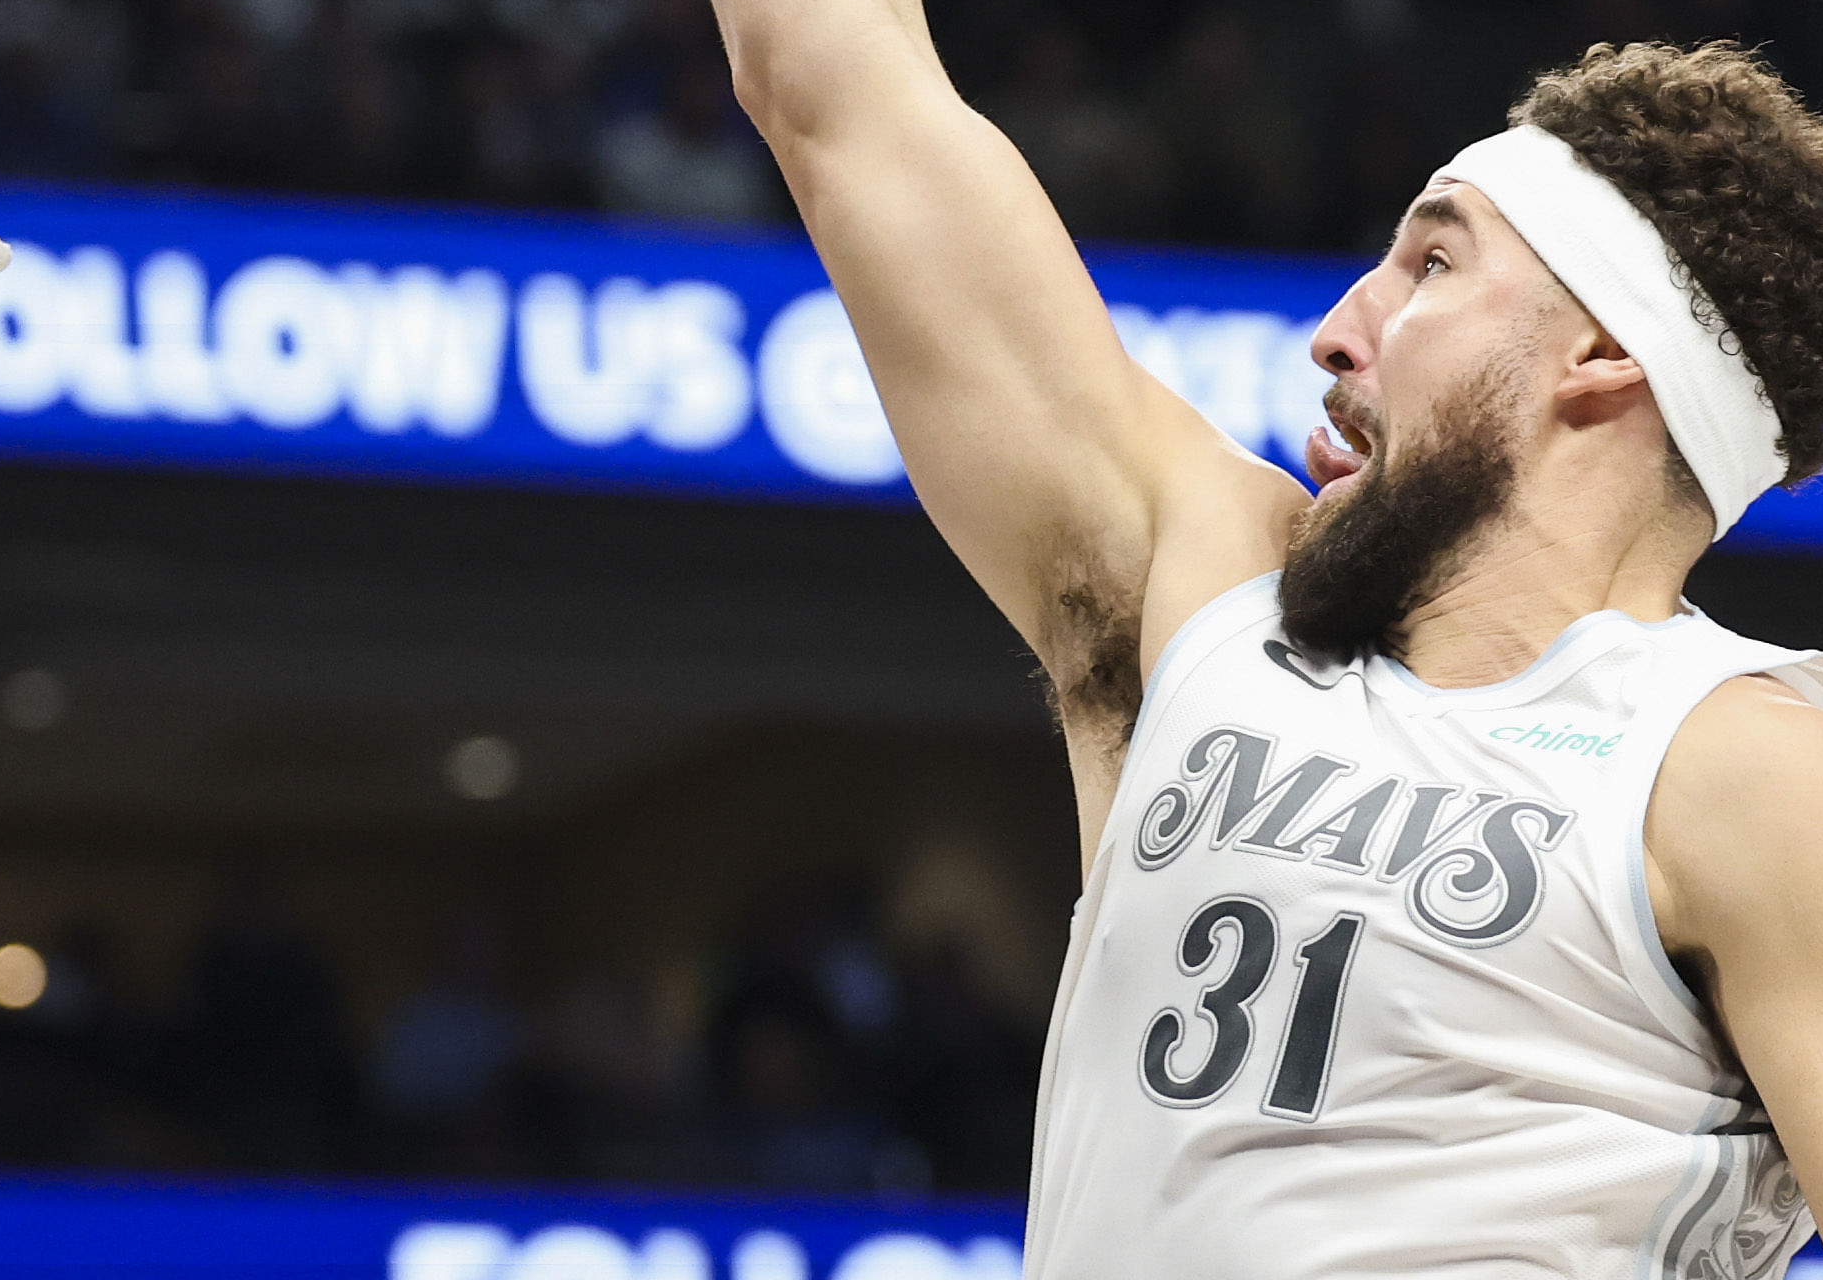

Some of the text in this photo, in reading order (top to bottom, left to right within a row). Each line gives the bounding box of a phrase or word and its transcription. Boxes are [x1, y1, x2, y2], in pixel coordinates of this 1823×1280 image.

[517, 271, 754, 451] US
[1133, 724, 1578, 949] MAVS
[1488, 723, 1625, 757] chime
[1137, 892, 1366, 1123] 31
